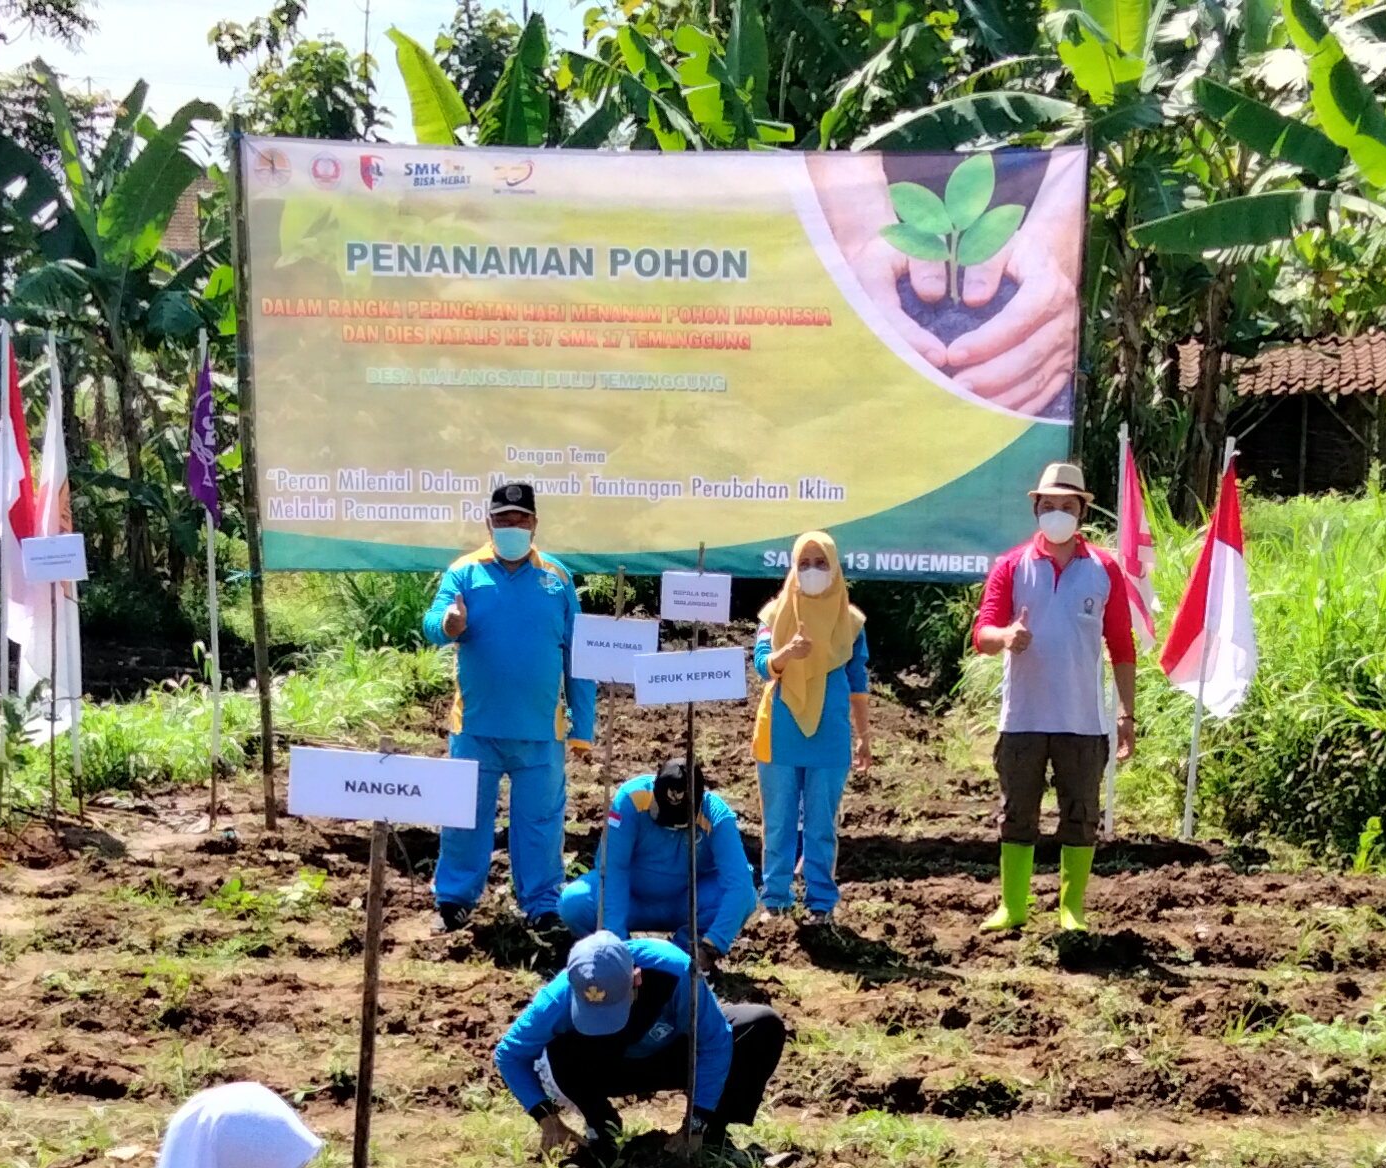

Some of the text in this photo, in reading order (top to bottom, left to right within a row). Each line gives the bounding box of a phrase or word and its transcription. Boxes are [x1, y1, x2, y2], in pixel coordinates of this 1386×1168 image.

[404, 163, 441, 176] SMK
[413, 175, 471, 187] BISA-HEBAT
[346, 242, 748, 280] PENANAMAN POHON
[262, 298, 832, 326] DALAM RANGKA PERINGATAN HARI MENANAM POHON INDONESIA
[342, 324, 751, 350] DAN DIES NATALIS KE 37 SMK 17 TEMANGGUNG
[366, 367, 727, 392] DESA MALANGSARI BULU TEMANGGUNG
[507, 447, 607, 465] Dengan Tema
[338, 468, 413, 493] Milenial
[420, 470, 480, 494] Dalam
[590, 475, 682, 501] Tantangan
[691, 476, 789, 501] Perubahan
[798, 477, 845, 501] Iklim
[268, 497, 335, 520] Melalui
[343, 499, 453, 522] Penanaman
[844, 553, 870, 570] 13
[875, 553, 989, 573] NOVEMBER
[586, 639, 644, 651] WAKA HUMAS
[648, 670, 731, 684] JERUK KEPROK
[344, 780, 422, 797] NANGKA
